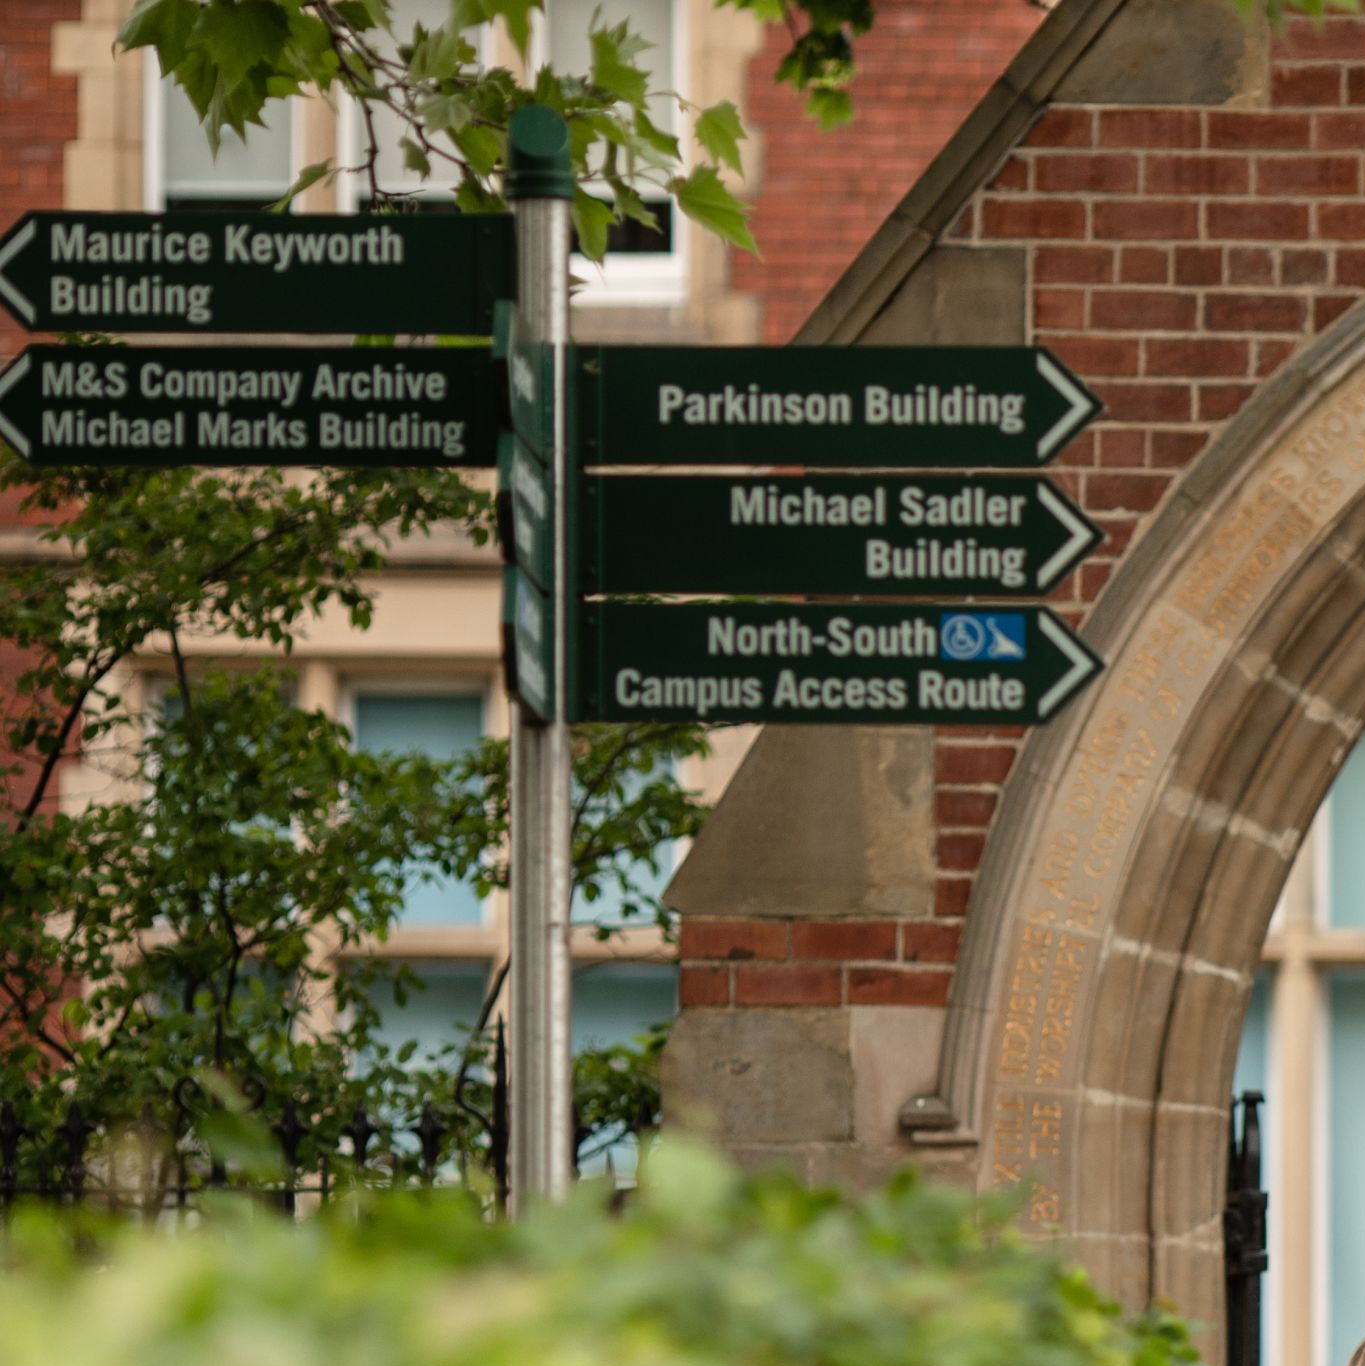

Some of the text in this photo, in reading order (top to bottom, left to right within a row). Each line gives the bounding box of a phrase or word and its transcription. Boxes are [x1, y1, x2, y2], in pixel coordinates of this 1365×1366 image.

[49, 222, 404, 272] Maurice Keyworth
[49, 274, 212, 324] Building
[41, 361, 447, 407] M&S Company Archive
[657, 384, 1025, 433] Parkinson Building
[41, 409, 466, 457] Michael Marks Building
[730, 485, 1026, 525] Michael Sadler
[865, 538, 1026, 588] Building
[707, 616, 937, 657] North-South
[614, 668, 1025, 715] Campus Access Route
[1035, 827, 1081, 899] AND
[1030, 1100, 1060, 1160] THE
[1079, 727, 1163, 880] COMPANY
